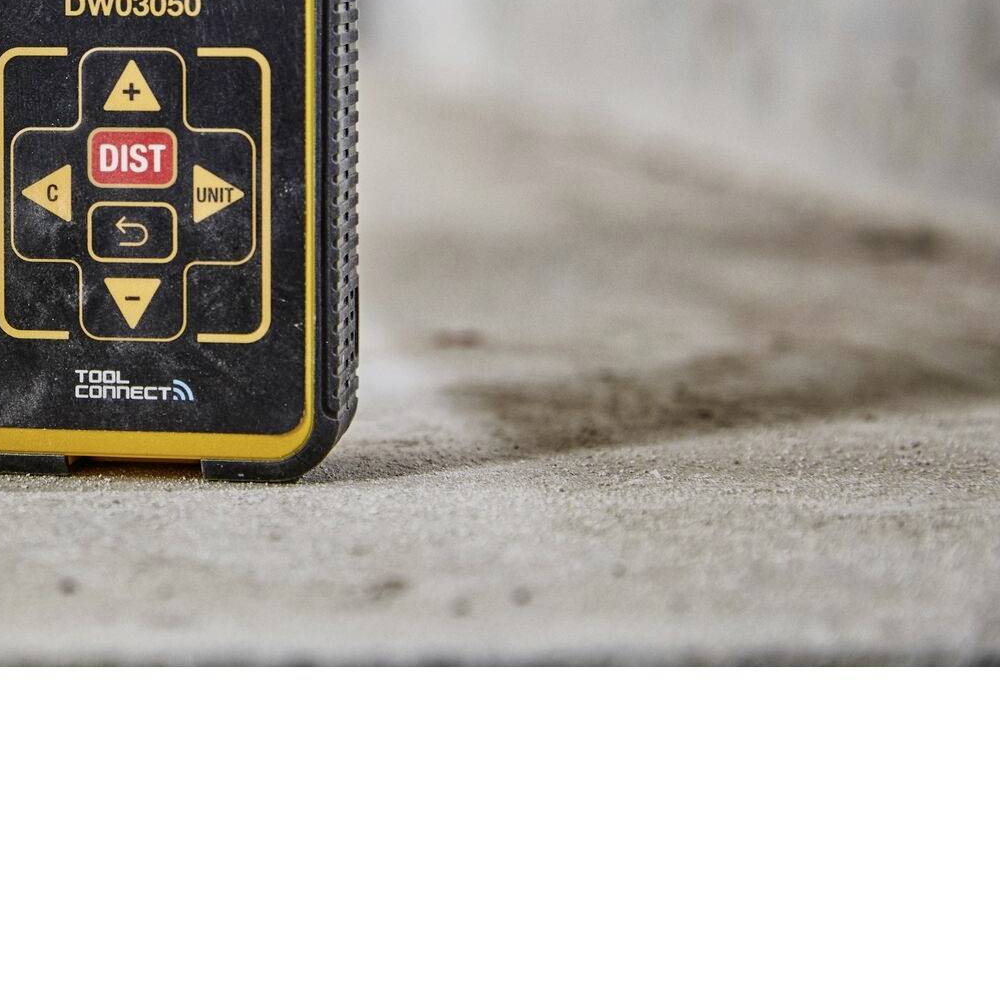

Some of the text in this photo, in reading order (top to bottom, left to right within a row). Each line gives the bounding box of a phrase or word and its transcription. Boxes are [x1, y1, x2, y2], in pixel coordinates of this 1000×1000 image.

[99, 143, 167, 173] DIST
[46, 184, 59, 203] C
[196, 187, 235, 204] UNIT
[75, 369, 130, 384] TOOL
[75, 385, 172, 400] CONNECT
